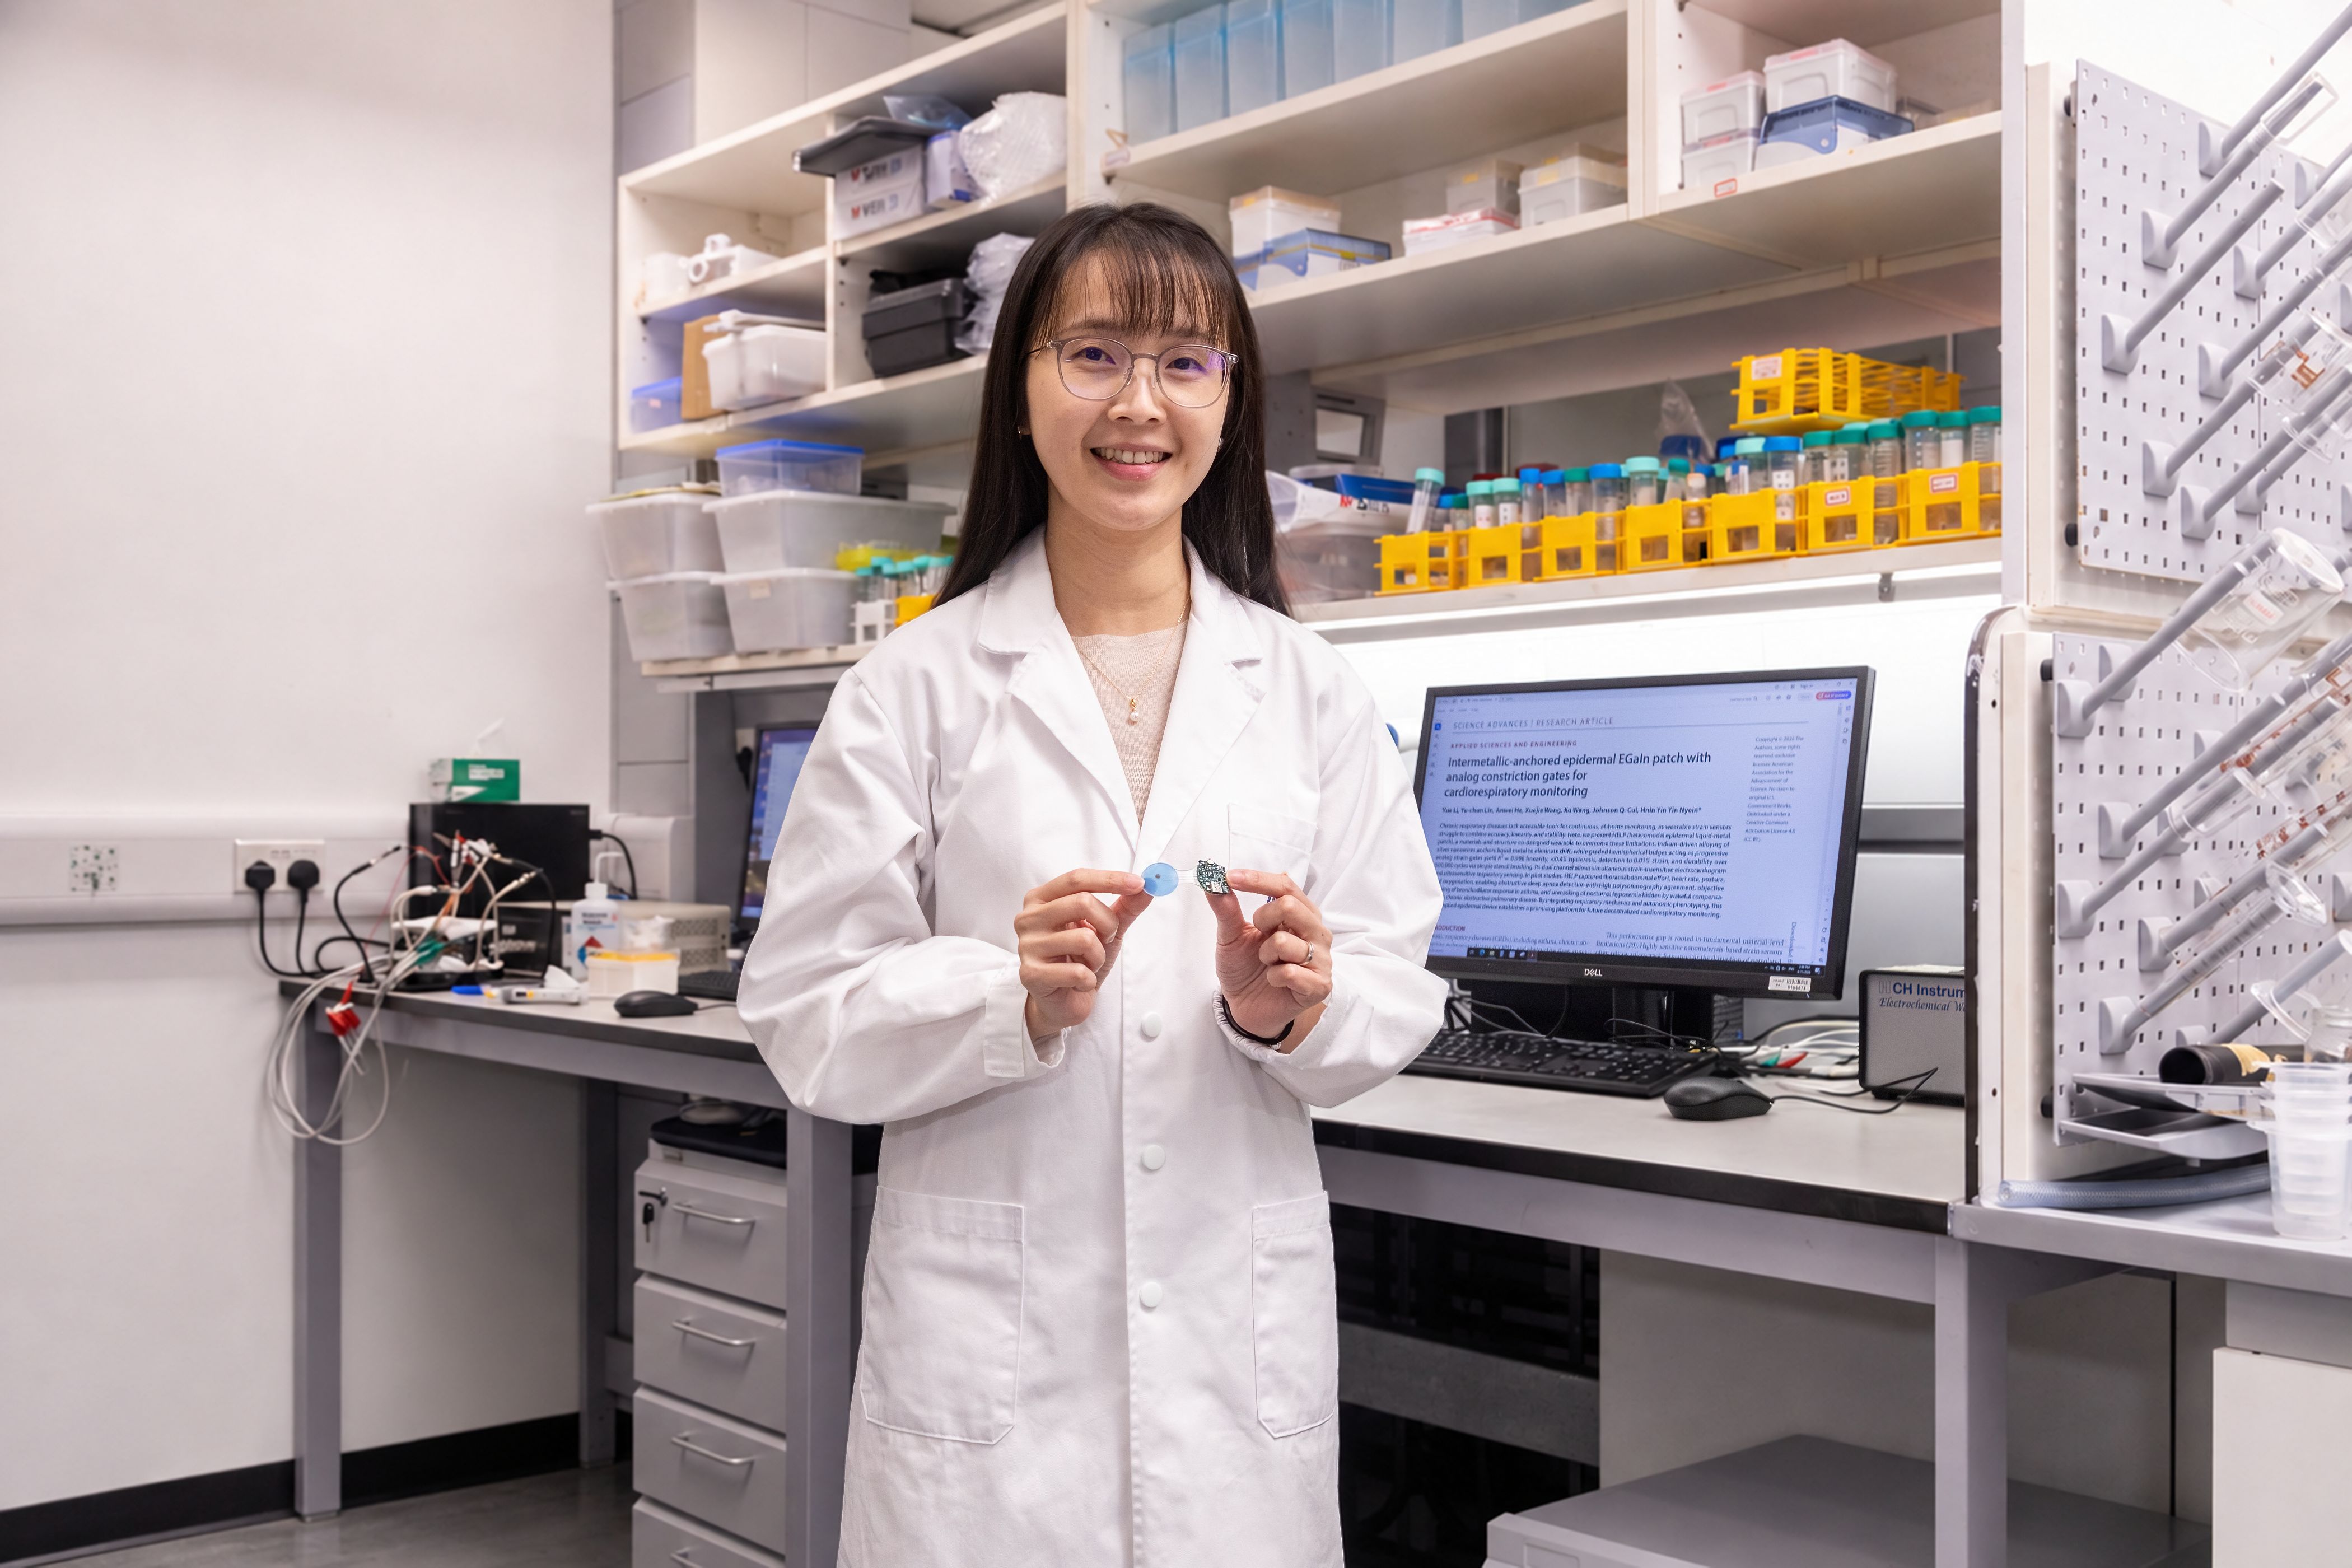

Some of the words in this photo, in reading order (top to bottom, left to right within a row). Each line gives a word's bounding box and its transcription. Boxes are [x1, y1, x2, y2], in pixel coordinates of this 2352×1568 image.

[1487, 720, 1528, 728] ADVANCES
[1536, 718, 1576, 726] RESEARCH
[1580, 717, 1613, 725] ARTICLE
[1448, 754, 1561, 767] Intermetallic-anchored
[1562, 753, 1616, 767] epidermal
[1618, 752, 1650, 764] EGaIn
[1653, 752, 1683, 766] patch
[1686, 751, 1711, 762] with
[1445, 771, 1479, 784] analog
[1481, 770, 1540, 781] constriction
[1542, 769, 1570, 783] gates
[1572, 769, 1588, 780] for
[1444, 786, 1528, 799] cardiorespiratory
[1530, 785, 1588, 799] monitoring
[1584, 968, 1603, 977] DELL
[1893, 982, 1912, 995] CH
[1879, 997, 1951, 1011] Electrochemical
